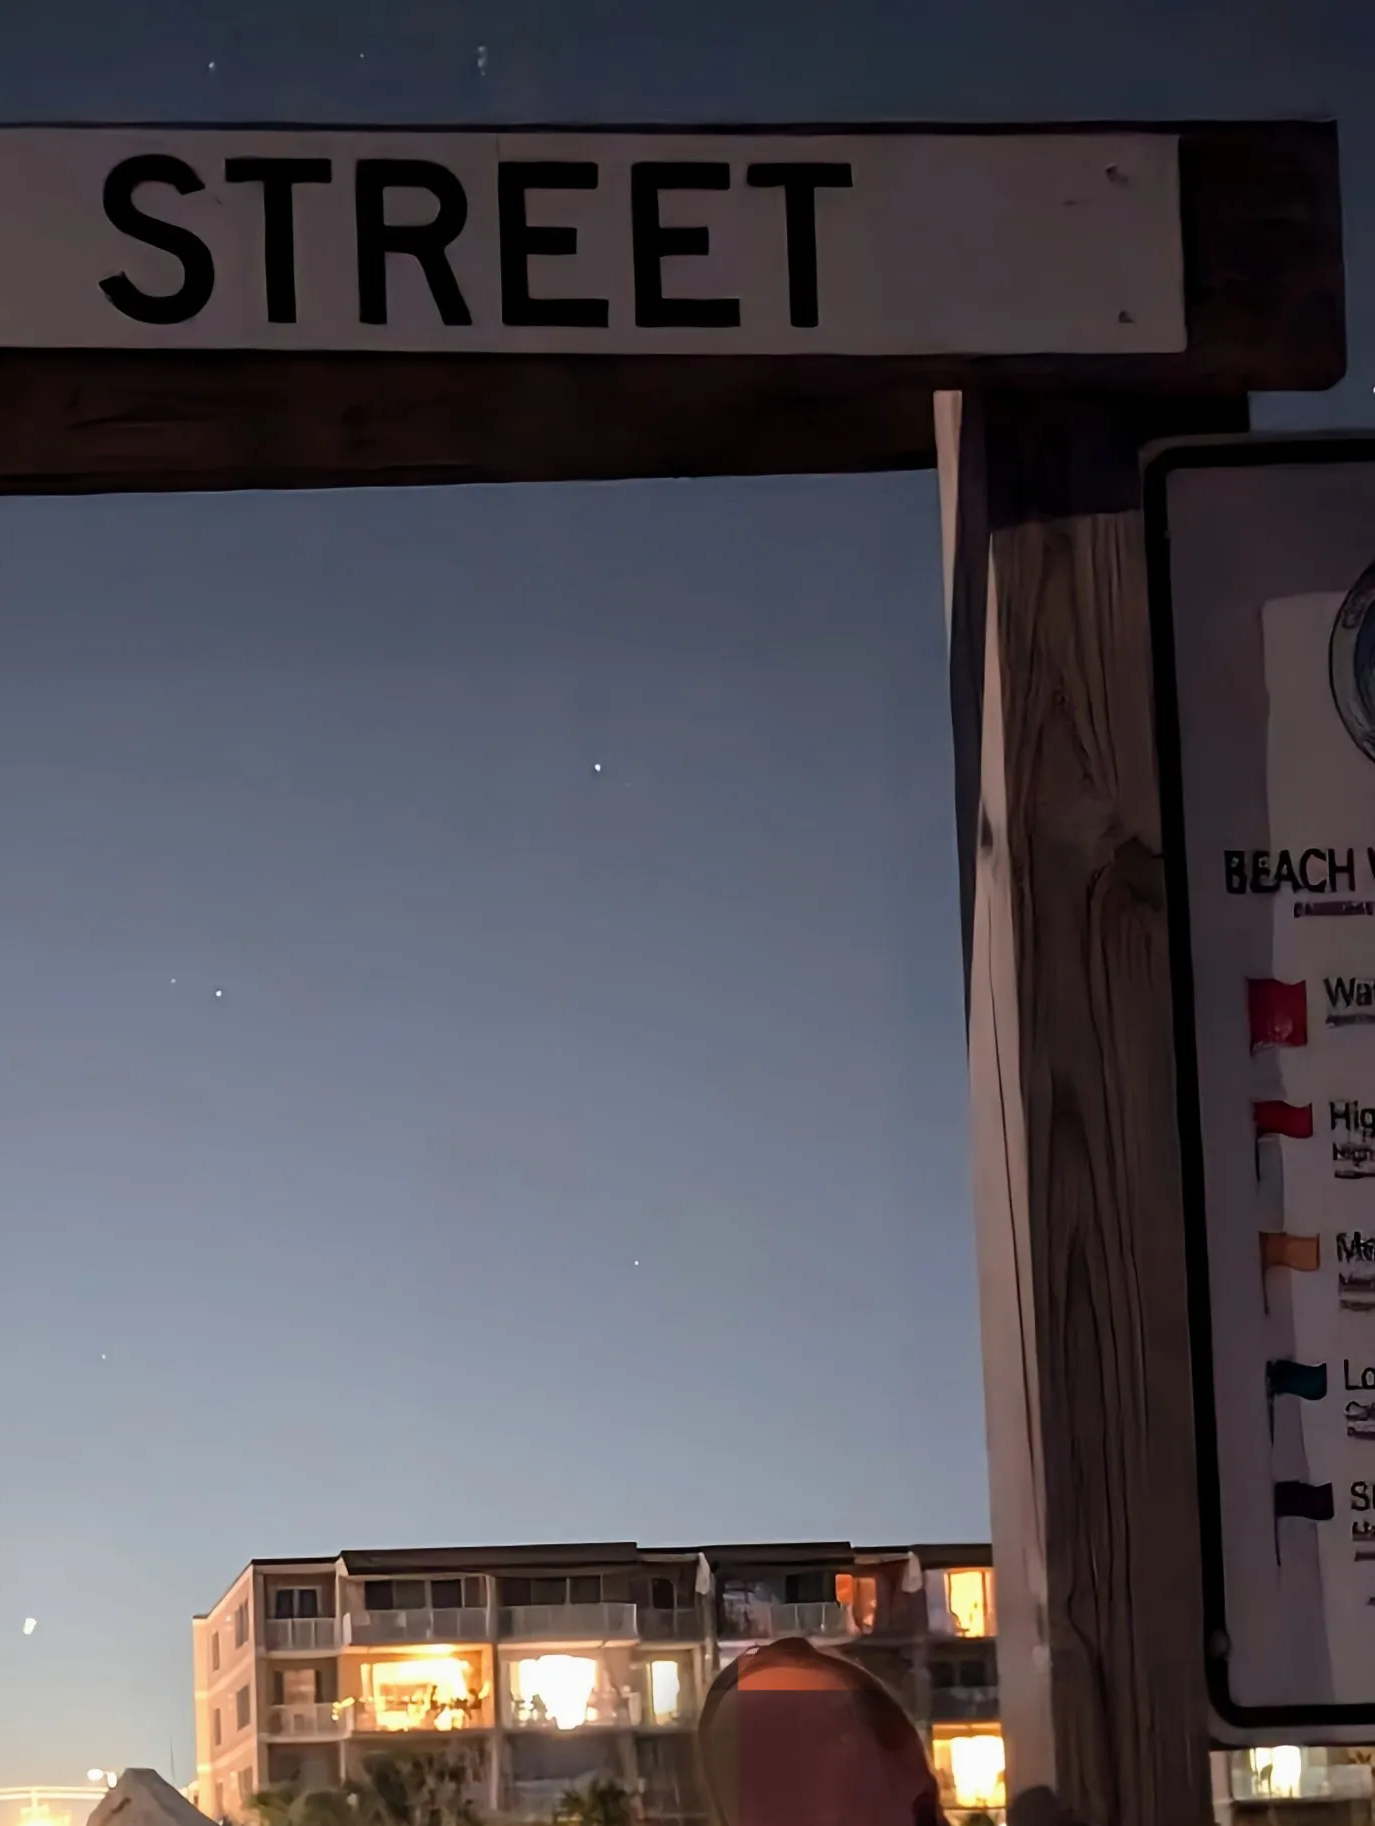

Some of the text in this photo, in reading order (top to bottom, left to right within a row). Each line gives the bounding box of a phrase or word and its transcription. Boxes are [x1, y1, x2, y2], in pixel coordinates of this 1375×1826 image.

[98, 153, 854, 328] STREET
[1223, 847, 1356, 894] BEACH
[1323, 977, 1375, 1008] Wa
[1351, 1481, 1375, 1512] S
